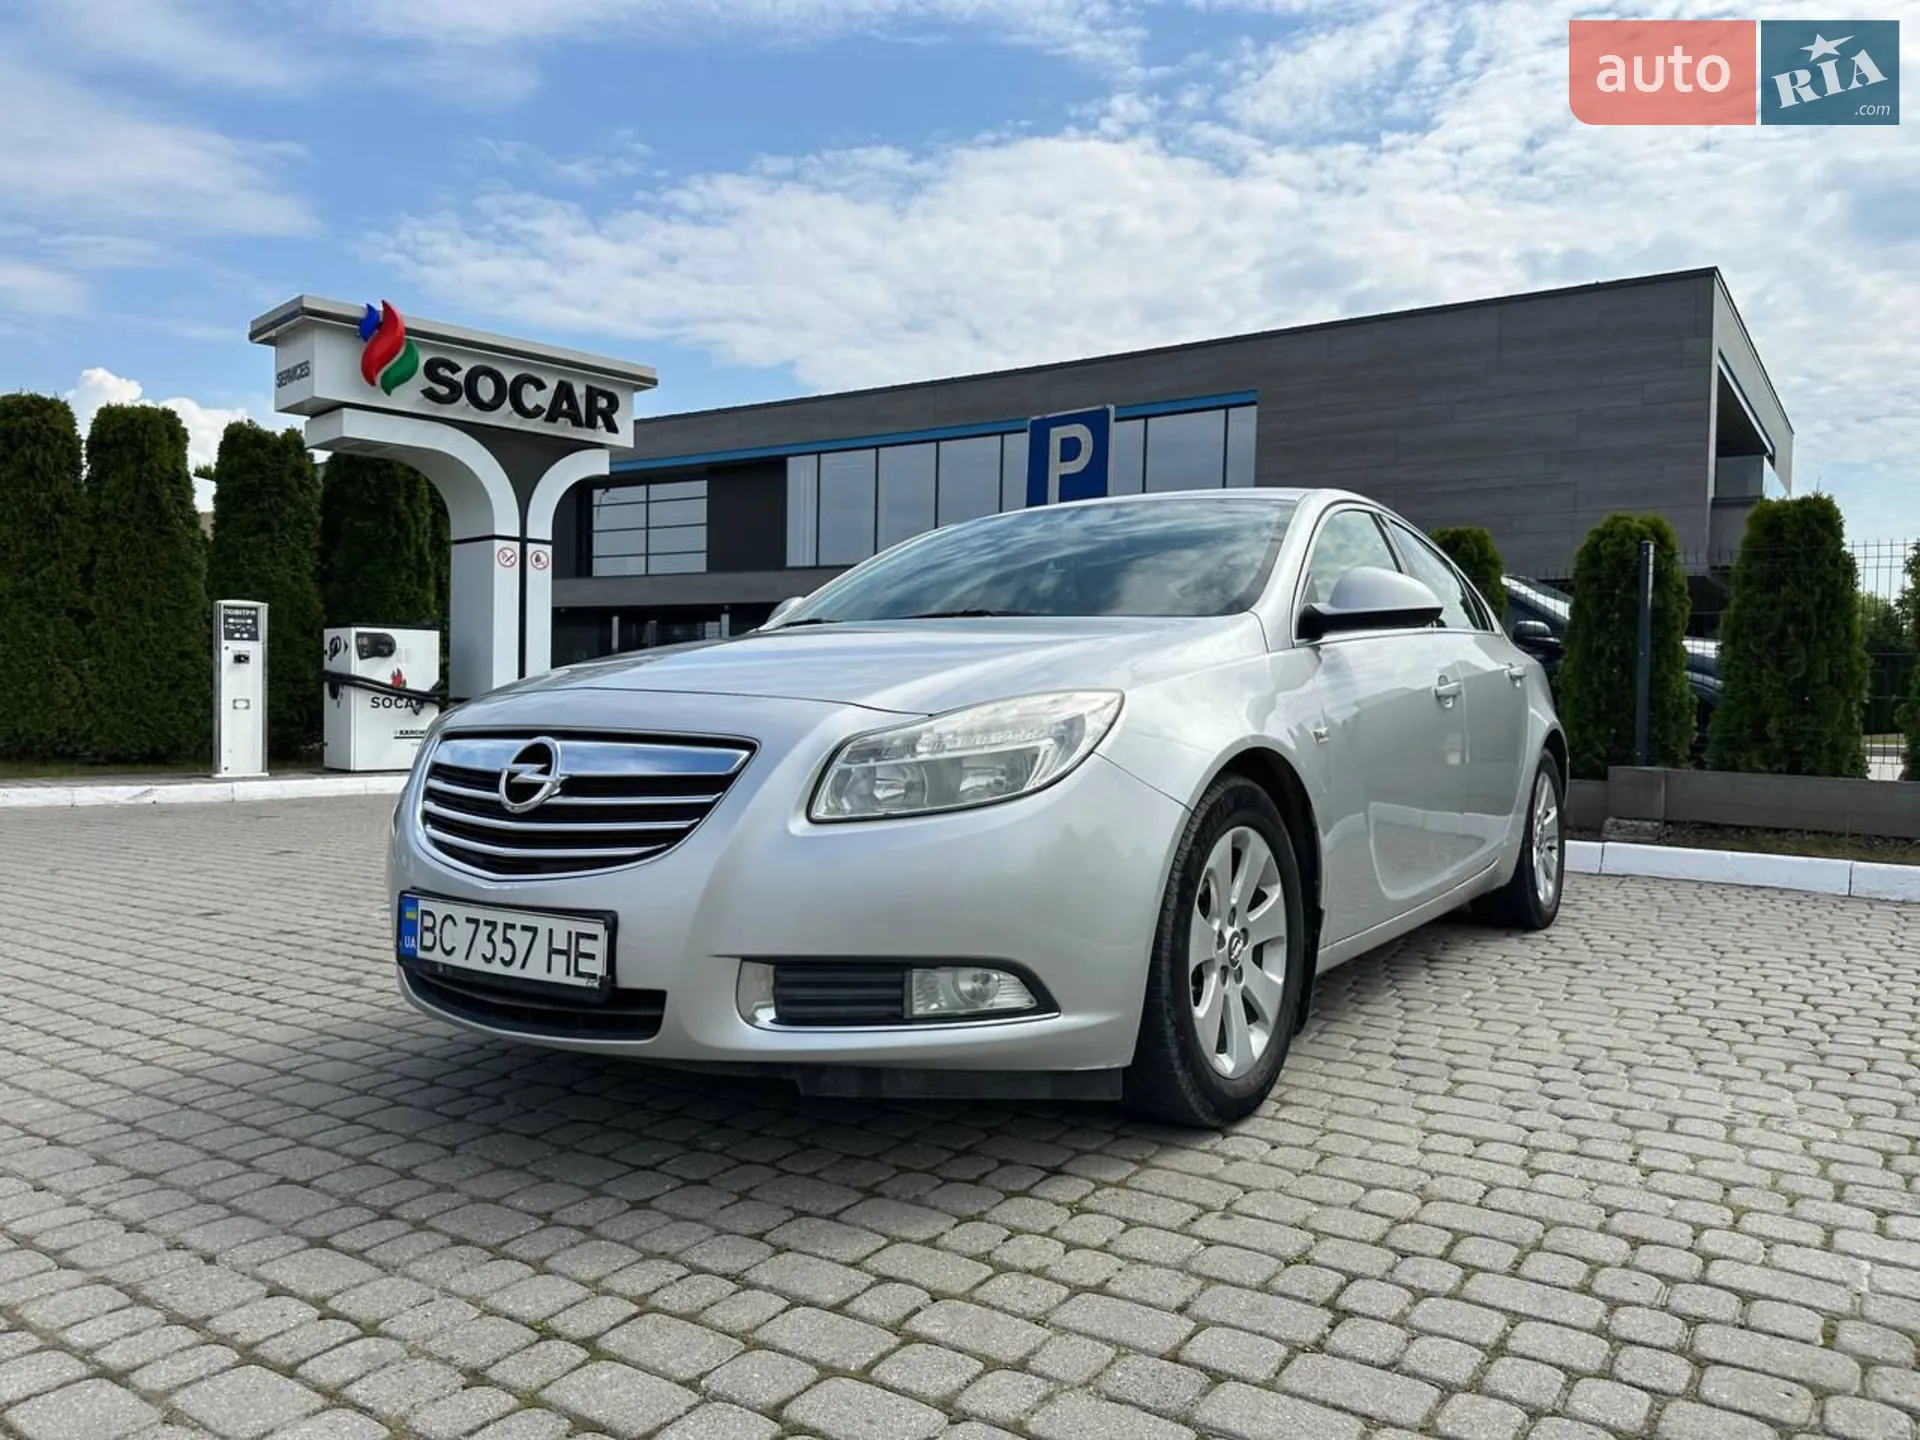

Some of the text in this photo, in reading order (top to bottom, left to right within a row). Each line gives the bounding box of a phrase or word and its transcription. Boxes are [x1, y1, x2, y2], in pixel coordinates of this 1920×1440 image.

[276, 360, 310, 388] SERVICES
[420, 356, 620, 434] SOCAR
[1047, 423, 1093, 504] P
[404, 935, 416, 949] UA
[420, 909, 599, 980] BC 7357 HE
